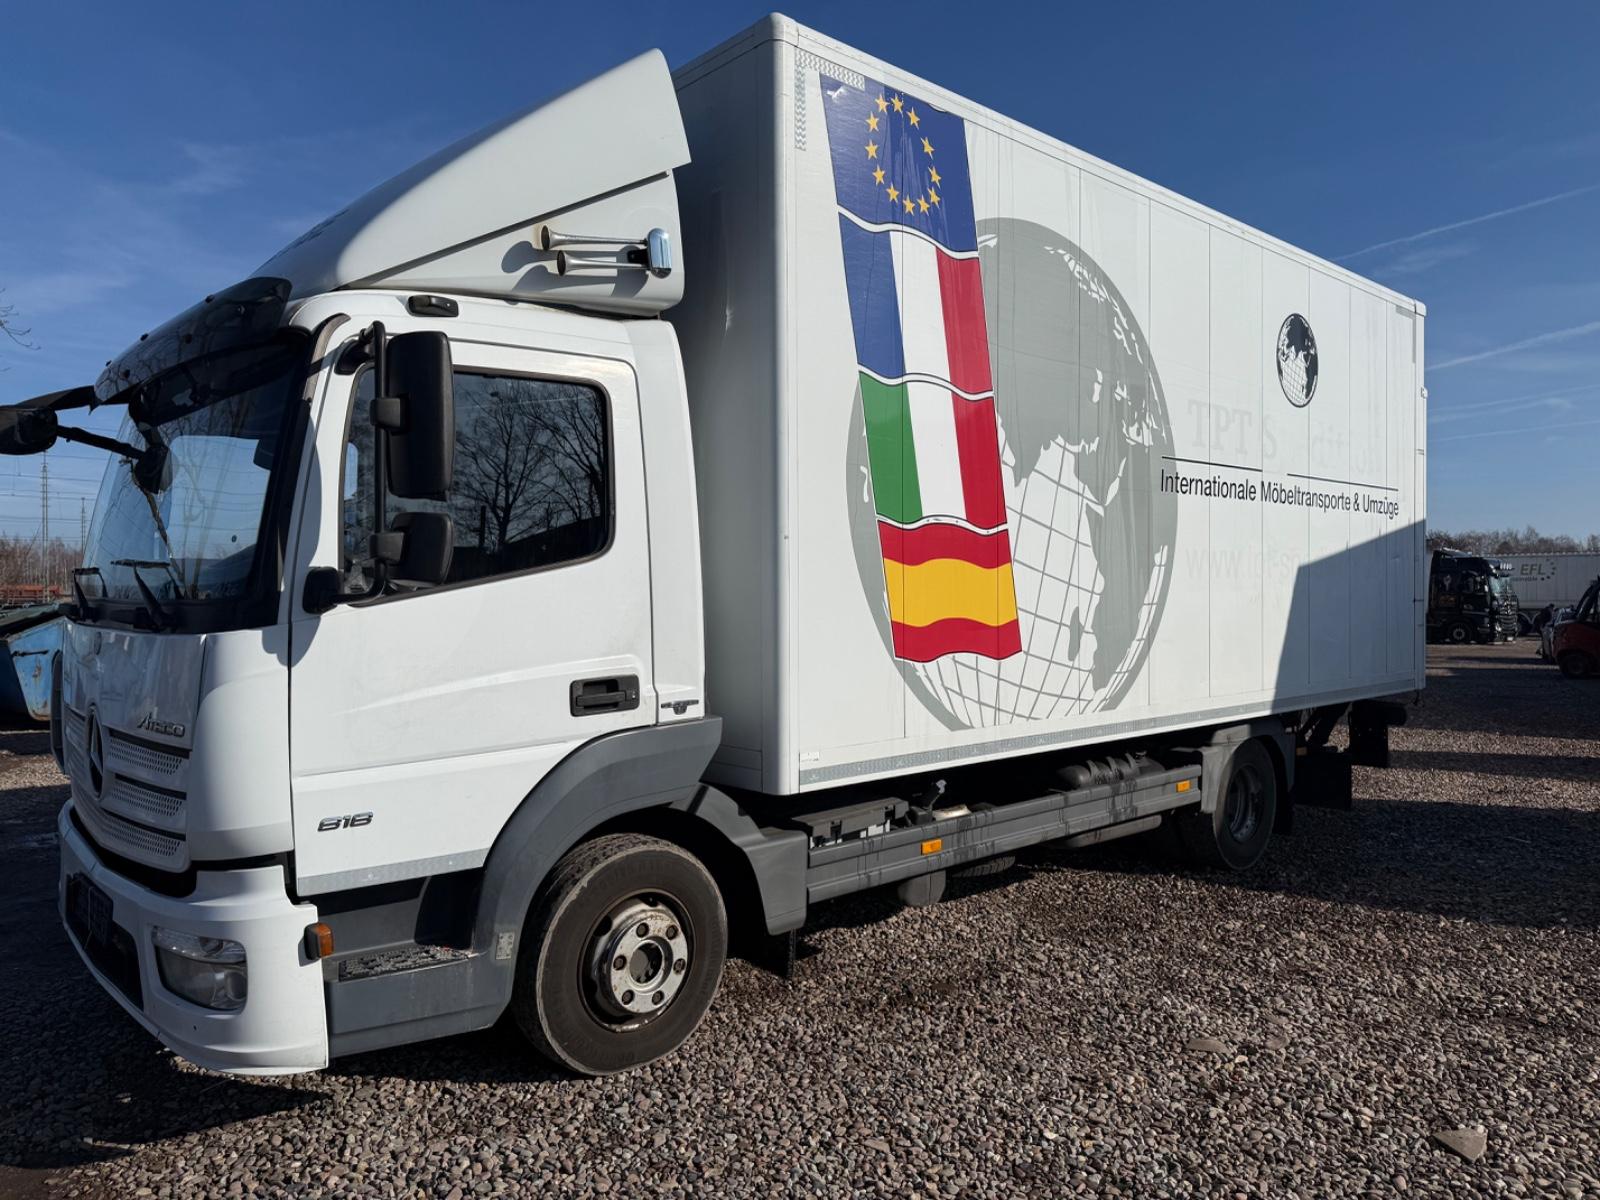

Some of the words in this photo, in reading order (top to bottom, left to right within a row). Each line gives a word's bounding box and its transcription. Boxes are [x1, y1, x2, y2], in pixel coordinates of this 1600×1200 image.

[1187, 398, 1253, 456] TPT
[1161, 469, 1257, 500] Internationale
[1260, 480, 1351, 513] Möbeltransporte
[1353, 492, 1360, 512] &
[1362, 494, 1399, 520] Umzüge
[1520, 563, 1546, 575] EFL
